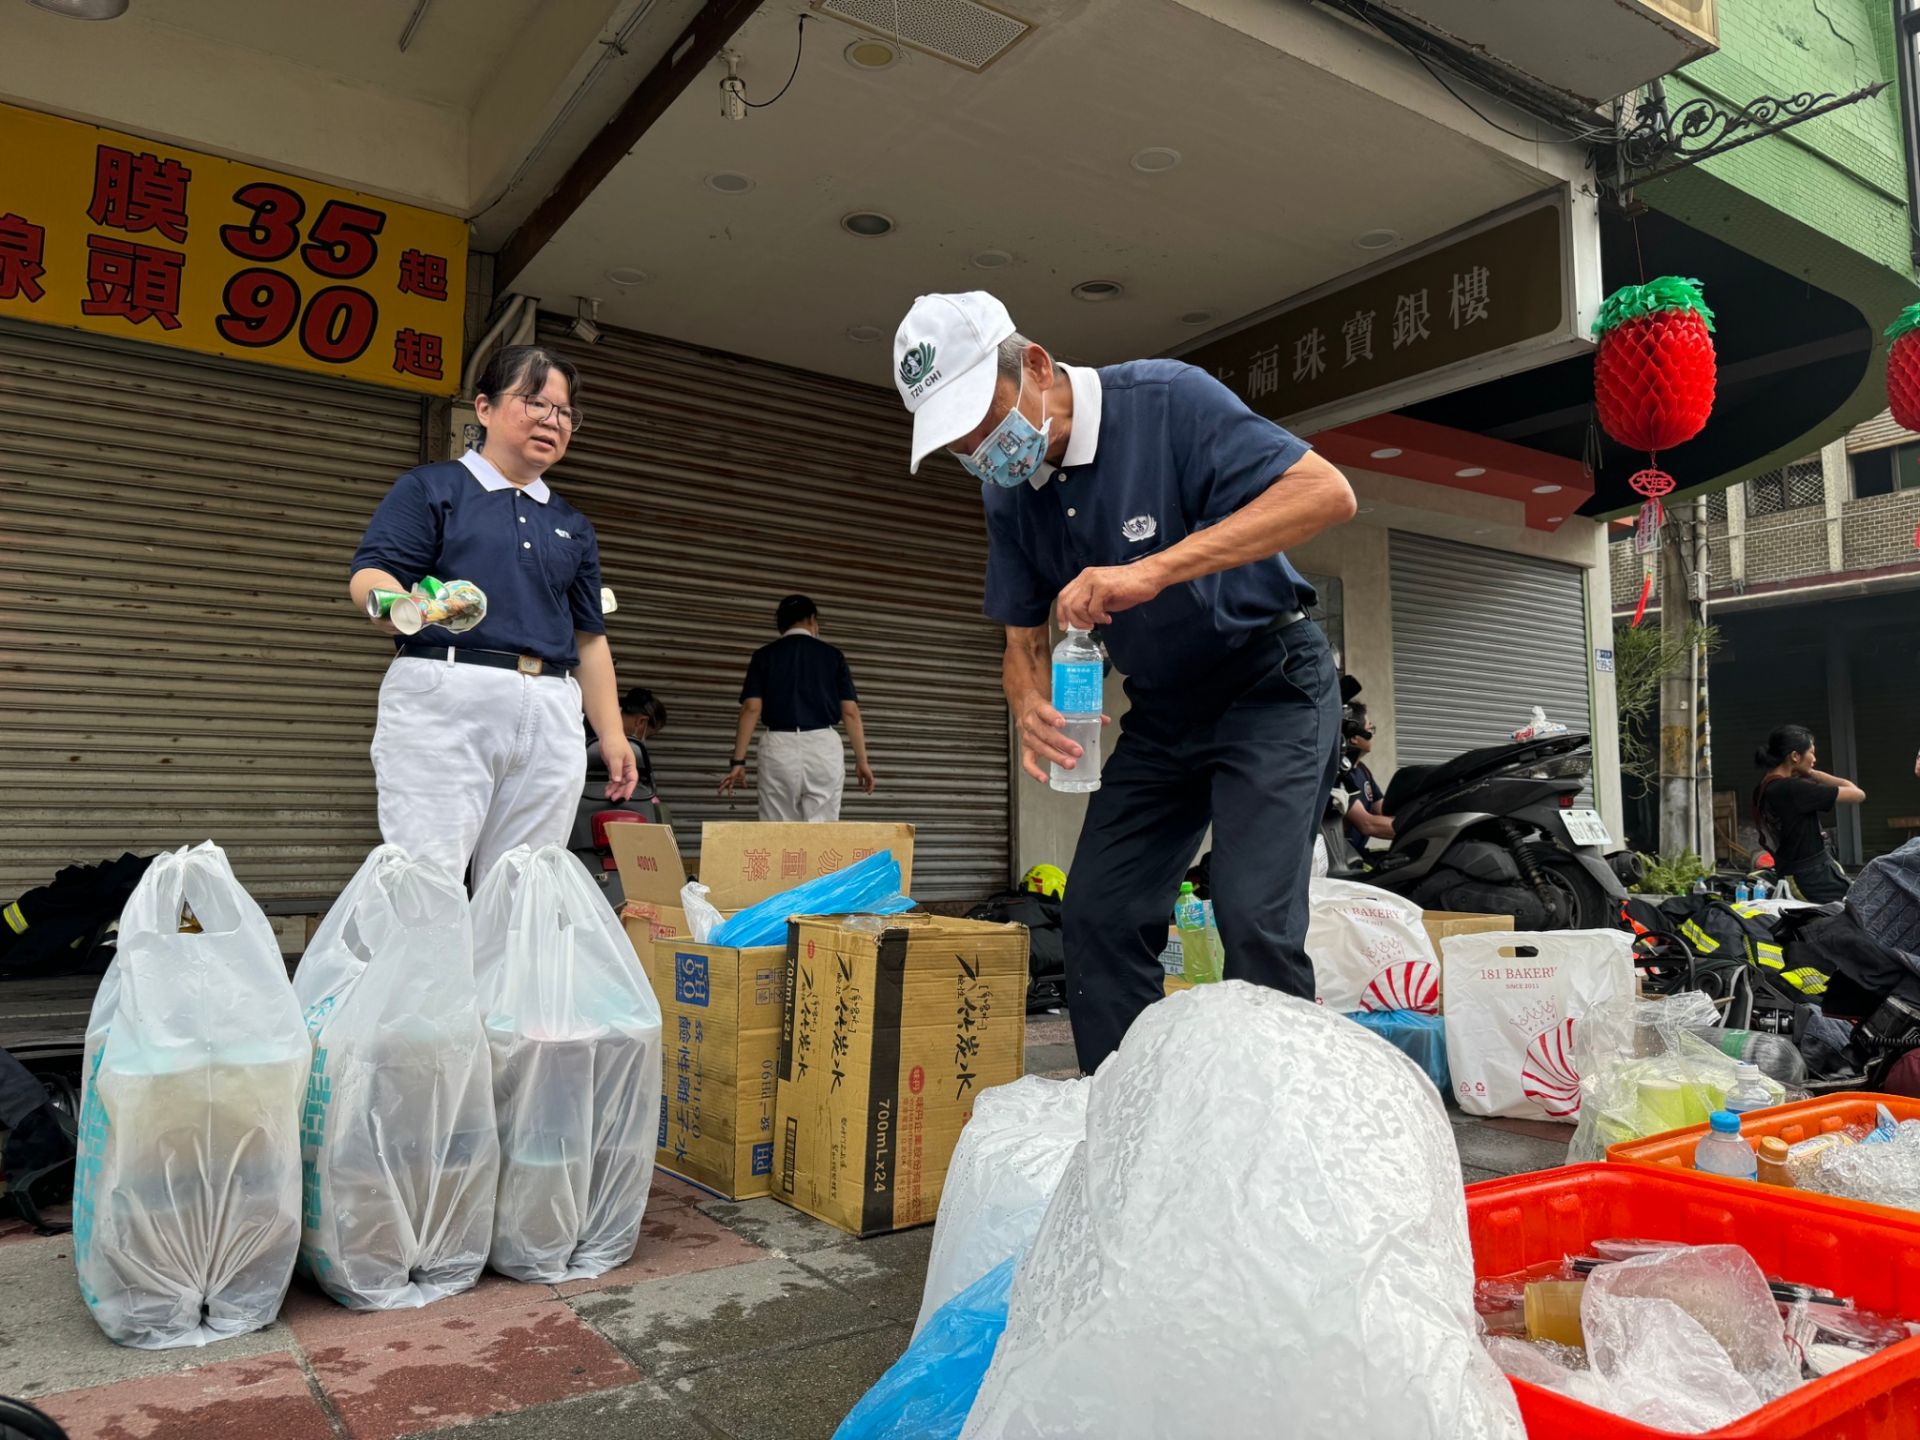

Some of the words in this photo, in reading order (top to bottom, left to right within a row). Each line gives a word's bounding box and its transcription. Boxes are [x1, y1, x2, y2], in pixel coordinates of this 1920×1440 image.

[86, 144, 192, 244] 膜
[219, 182, 387, 279] 35
[398, 248, 448, 301] 起
[81, 233, 186, 330] 頭
[215, 267, 379, 363] 90
[392, 328, 444, 380] 起
[1214, 265, 1491, 400] 福珠寶銀樓
[910, 385, 924, 400] TZU
[925, 370, 942, 387] CHI
[1352, 907, 1400, 919] BAKERY
[682, 959, 695, 998] 9.0
[694, 962, 706, 1000] PH
[1481, 968, 1501, 980] 181
[873, 1099, 890, 1193] 700mLx24
